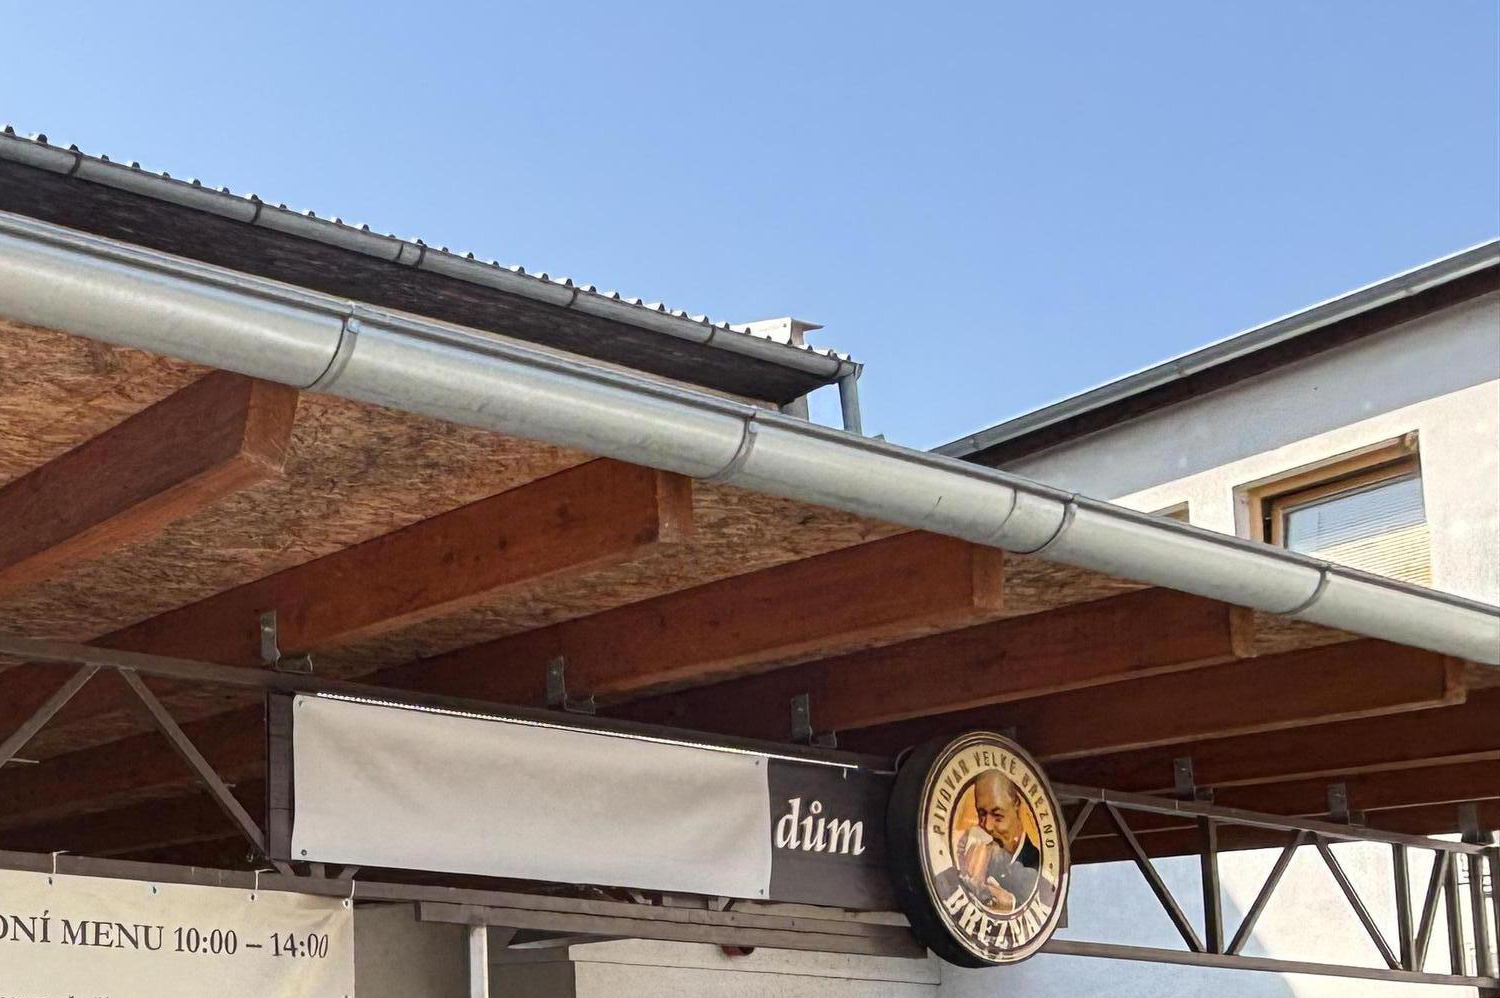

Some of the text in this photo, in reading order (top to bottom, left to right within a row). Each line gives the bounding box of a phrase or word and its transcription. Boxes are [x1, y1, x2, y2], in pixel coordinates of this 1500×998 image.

[775, 796, 867, 857] dům
[932, 757, 970, 837] PIVOVAR
[60, 918, 165, 951] MENU
[173, 926, 239, 956] 10:00
[269, 932, 330, 959] 14:00
